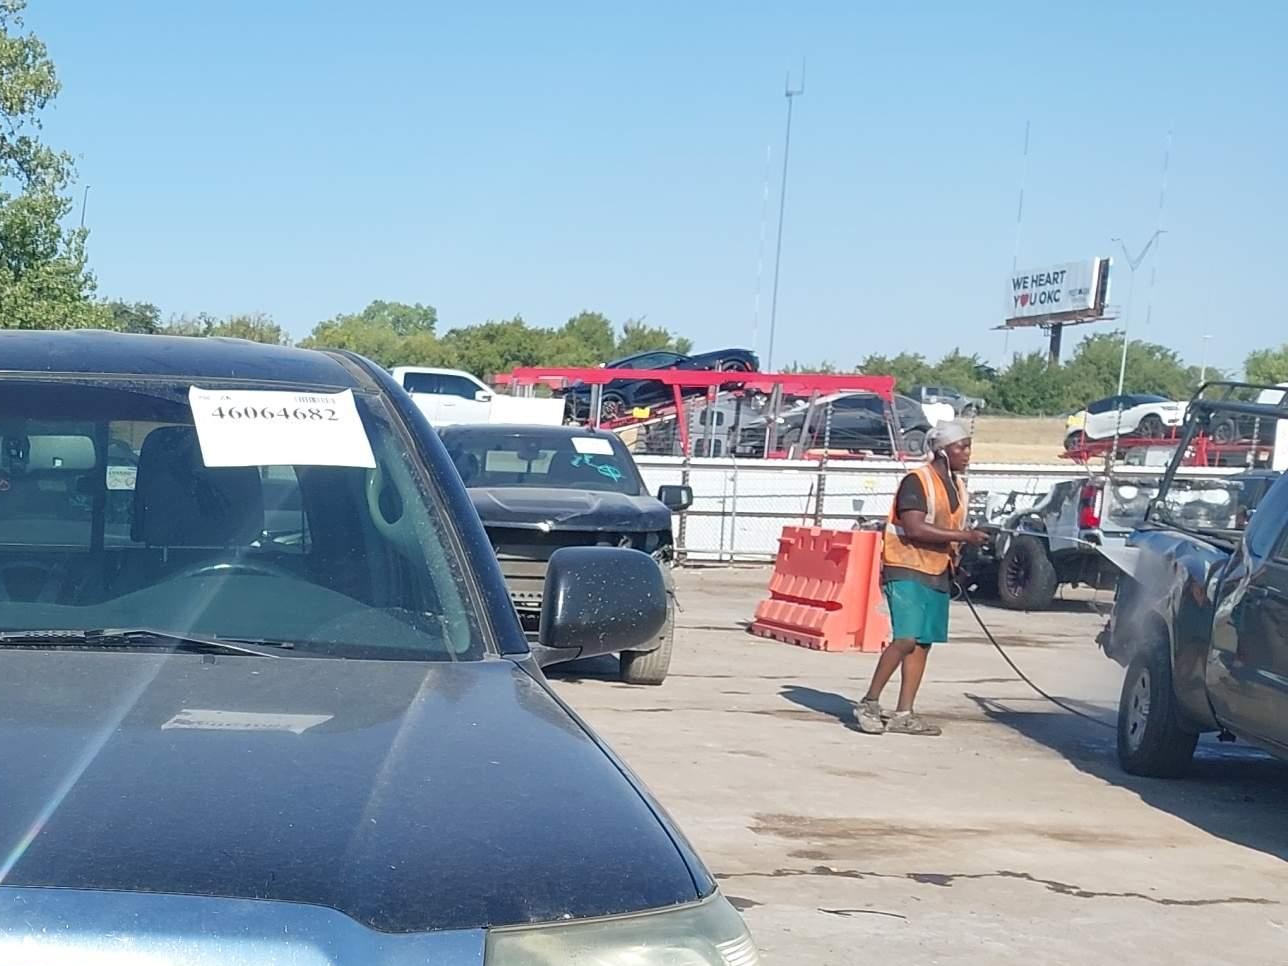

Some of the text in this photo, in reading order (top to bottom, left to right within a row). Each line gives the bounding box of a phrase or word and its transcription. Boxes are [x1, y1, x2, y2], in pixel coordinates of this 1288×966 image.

[1012, 270, 1067, 291] WE HEART
[211, 406, 339, 422] 46064682
